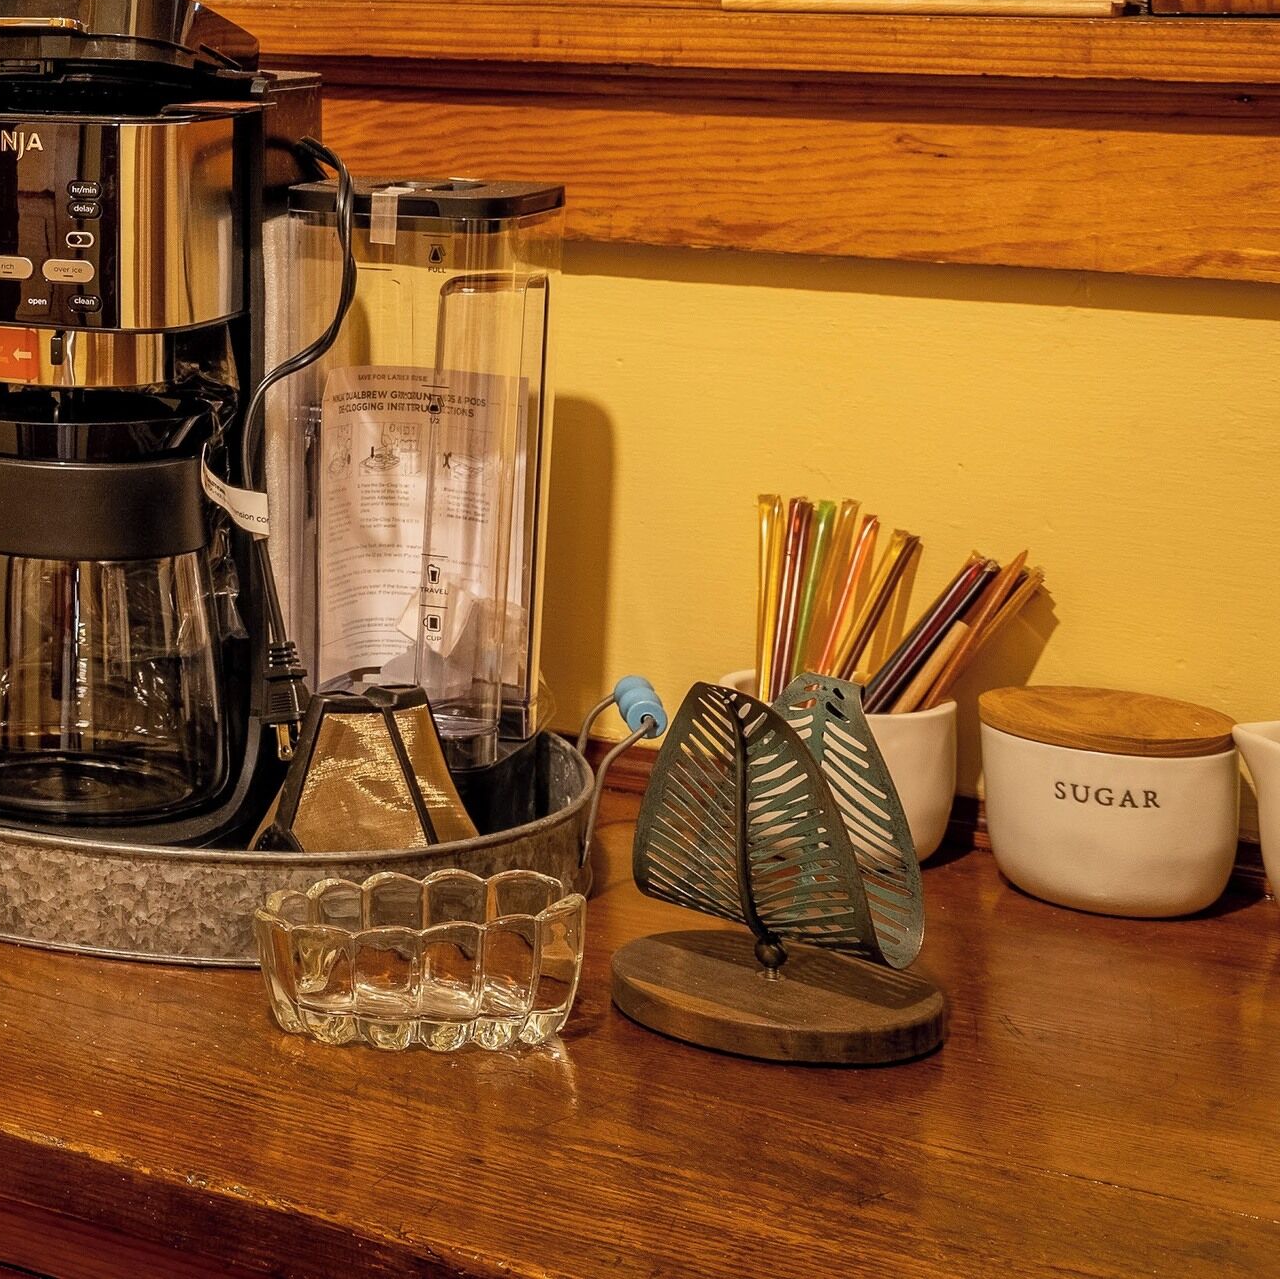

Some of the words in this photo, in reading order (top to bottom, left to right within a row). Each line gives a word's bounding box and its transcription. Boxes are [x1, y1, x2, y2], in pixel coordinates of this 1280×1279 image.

[71, 186, 97, 194] hr/min
[73, 205, 95, 213] delay
[0, 262, 15, 270] rich
[53, 266, 69, 274] over
[70, 266, 83, 274] ice
[28, 298, 47, 306] open
[74, 297, 95, 305] clean
[420, 587, 449, 596] TRAVEL
[1054, 781, 1161, 809] SUGAR
